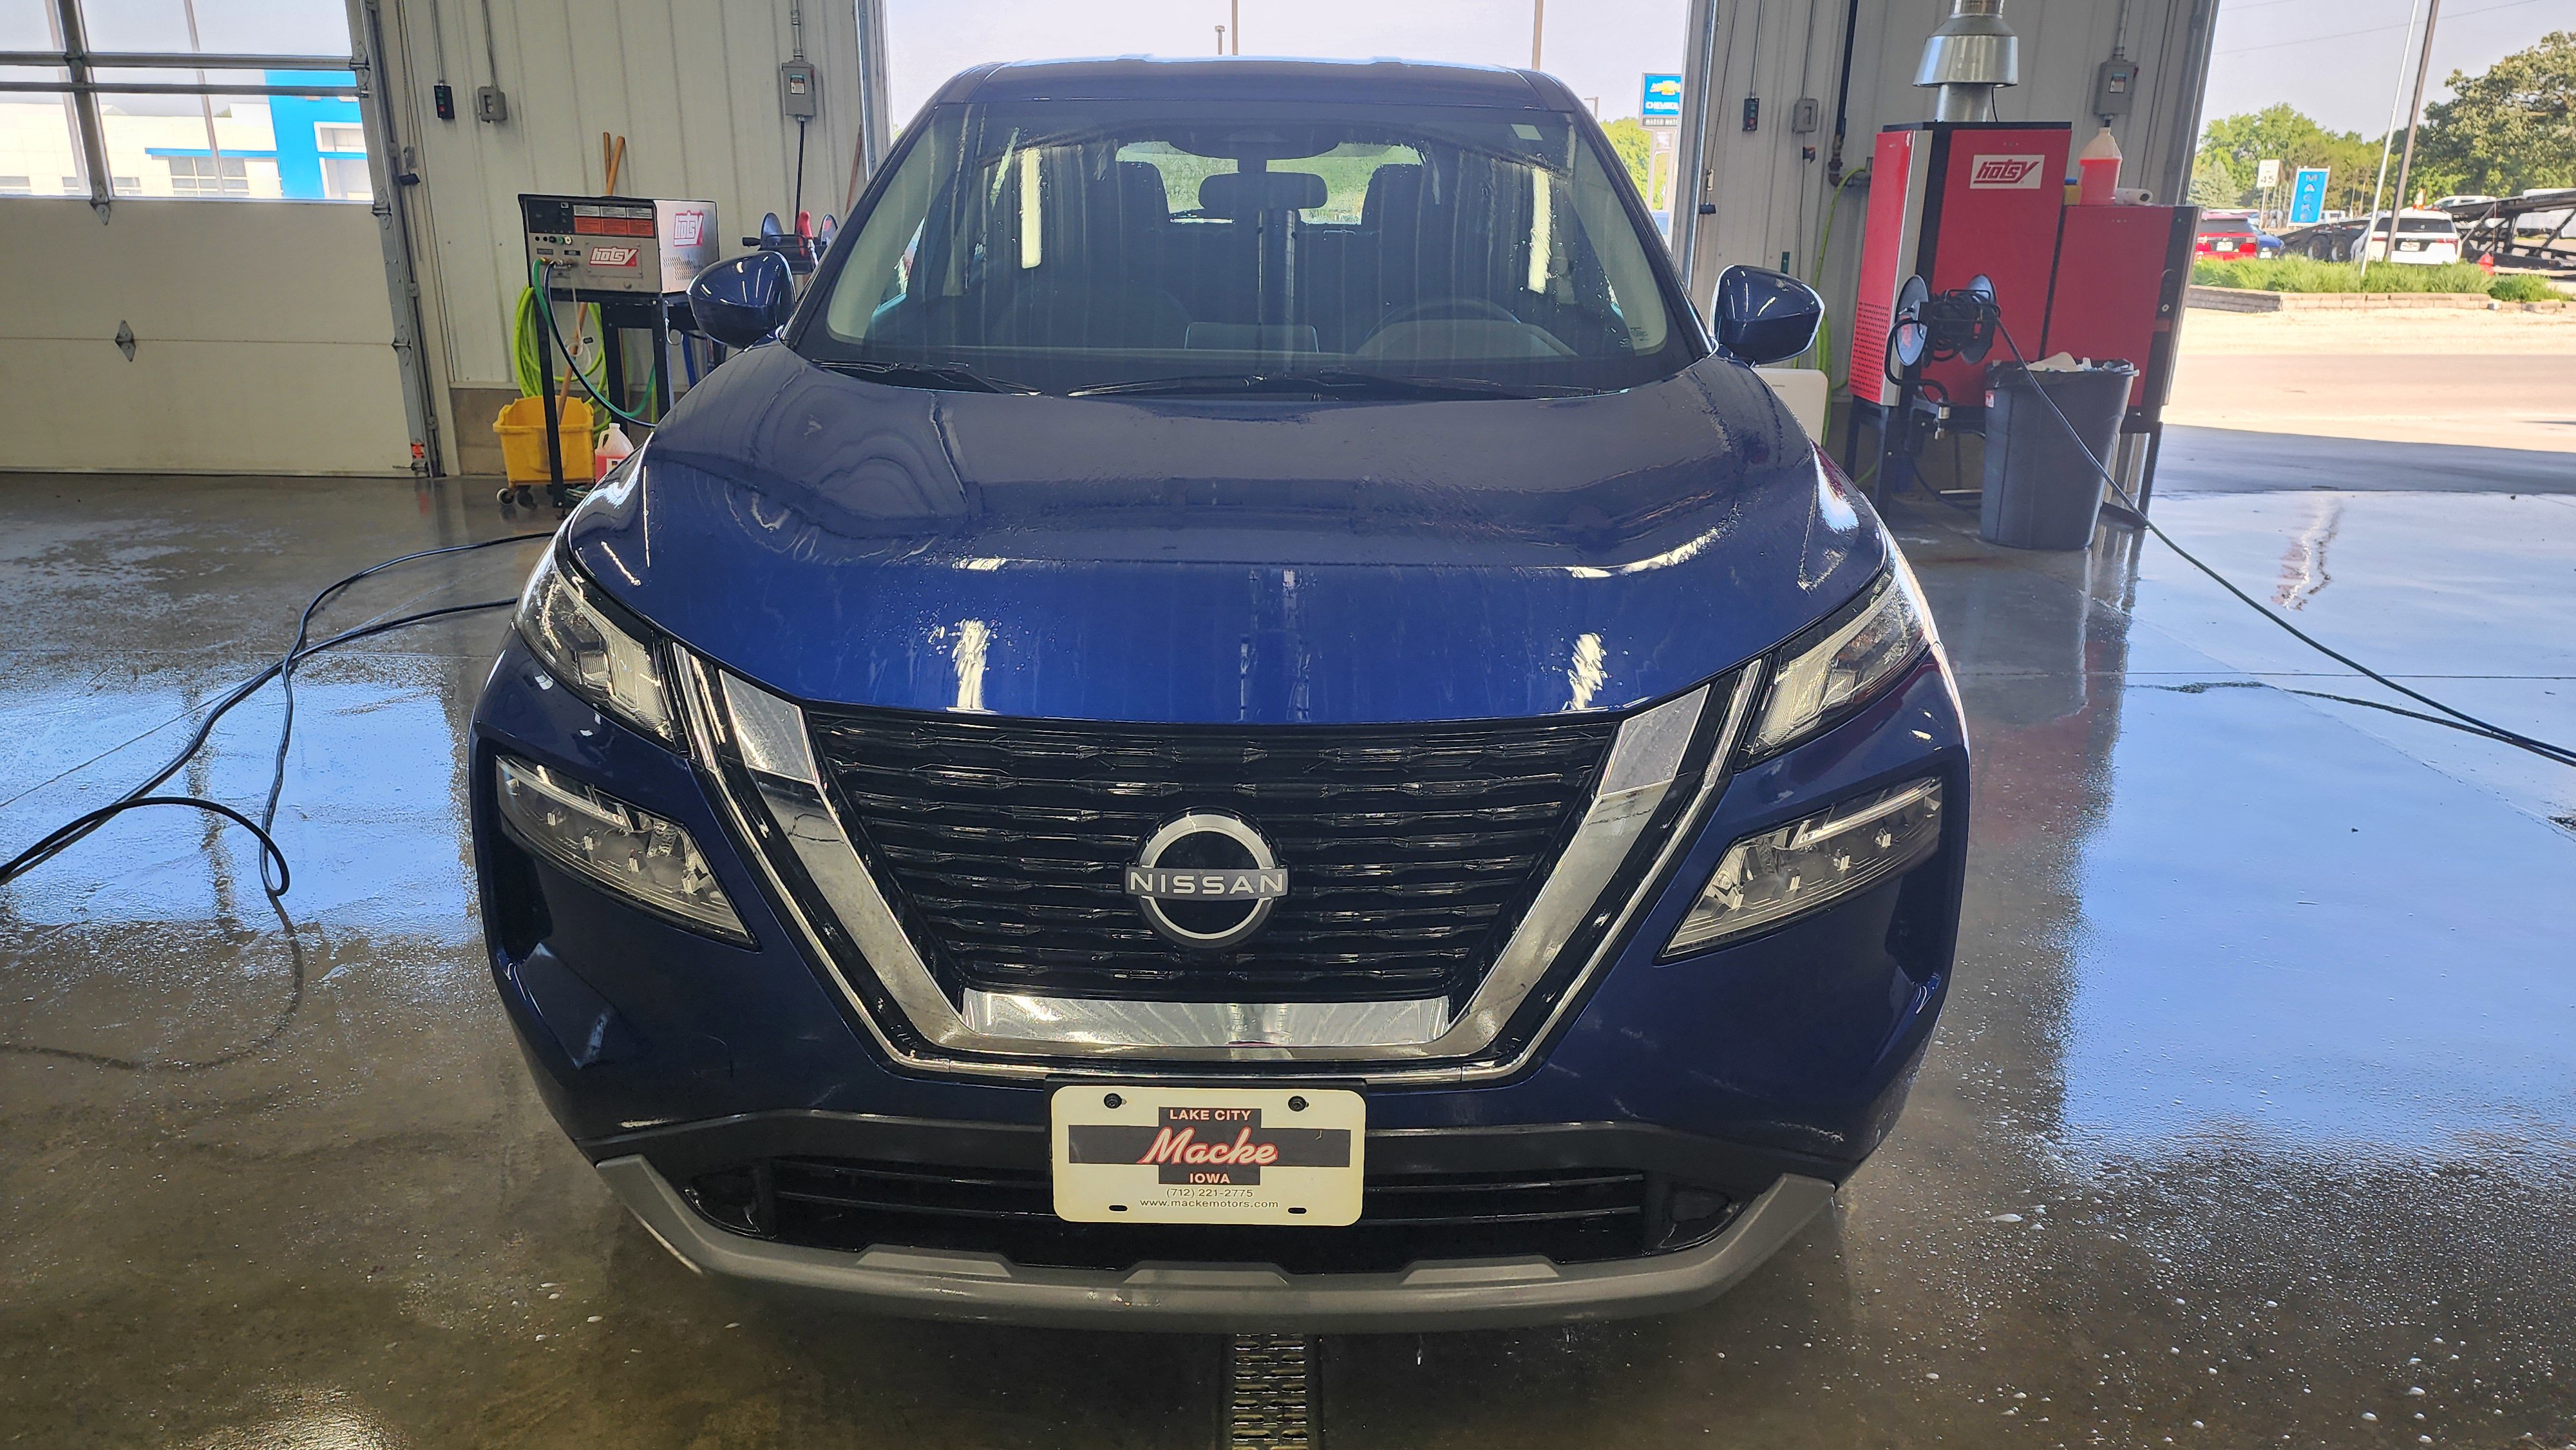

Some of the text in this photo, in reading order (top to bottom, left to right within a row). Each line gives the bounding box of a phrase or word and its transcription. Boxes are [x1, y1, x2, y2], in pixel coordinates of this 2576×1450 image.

[1645, 100, 1680, 111] CHEVROL
[1973, 158, 2040, 184] hotsy
[2260, 174, 2275, 184] 45
[590, 247, 638, 265] hotsy
[1130, 872, 1283, 894] NISSAN
[1169, 1109, 1252, 1122] LAKE CITY
[1137, 1126, 1278, 1165] Macke
[1189, 1172, 1231, 1185] IOWA
[1166, 1188, 1254, 1198] (712) 221-2775
[1139, 1199, 1279, 1208] www.mackemotors.com
